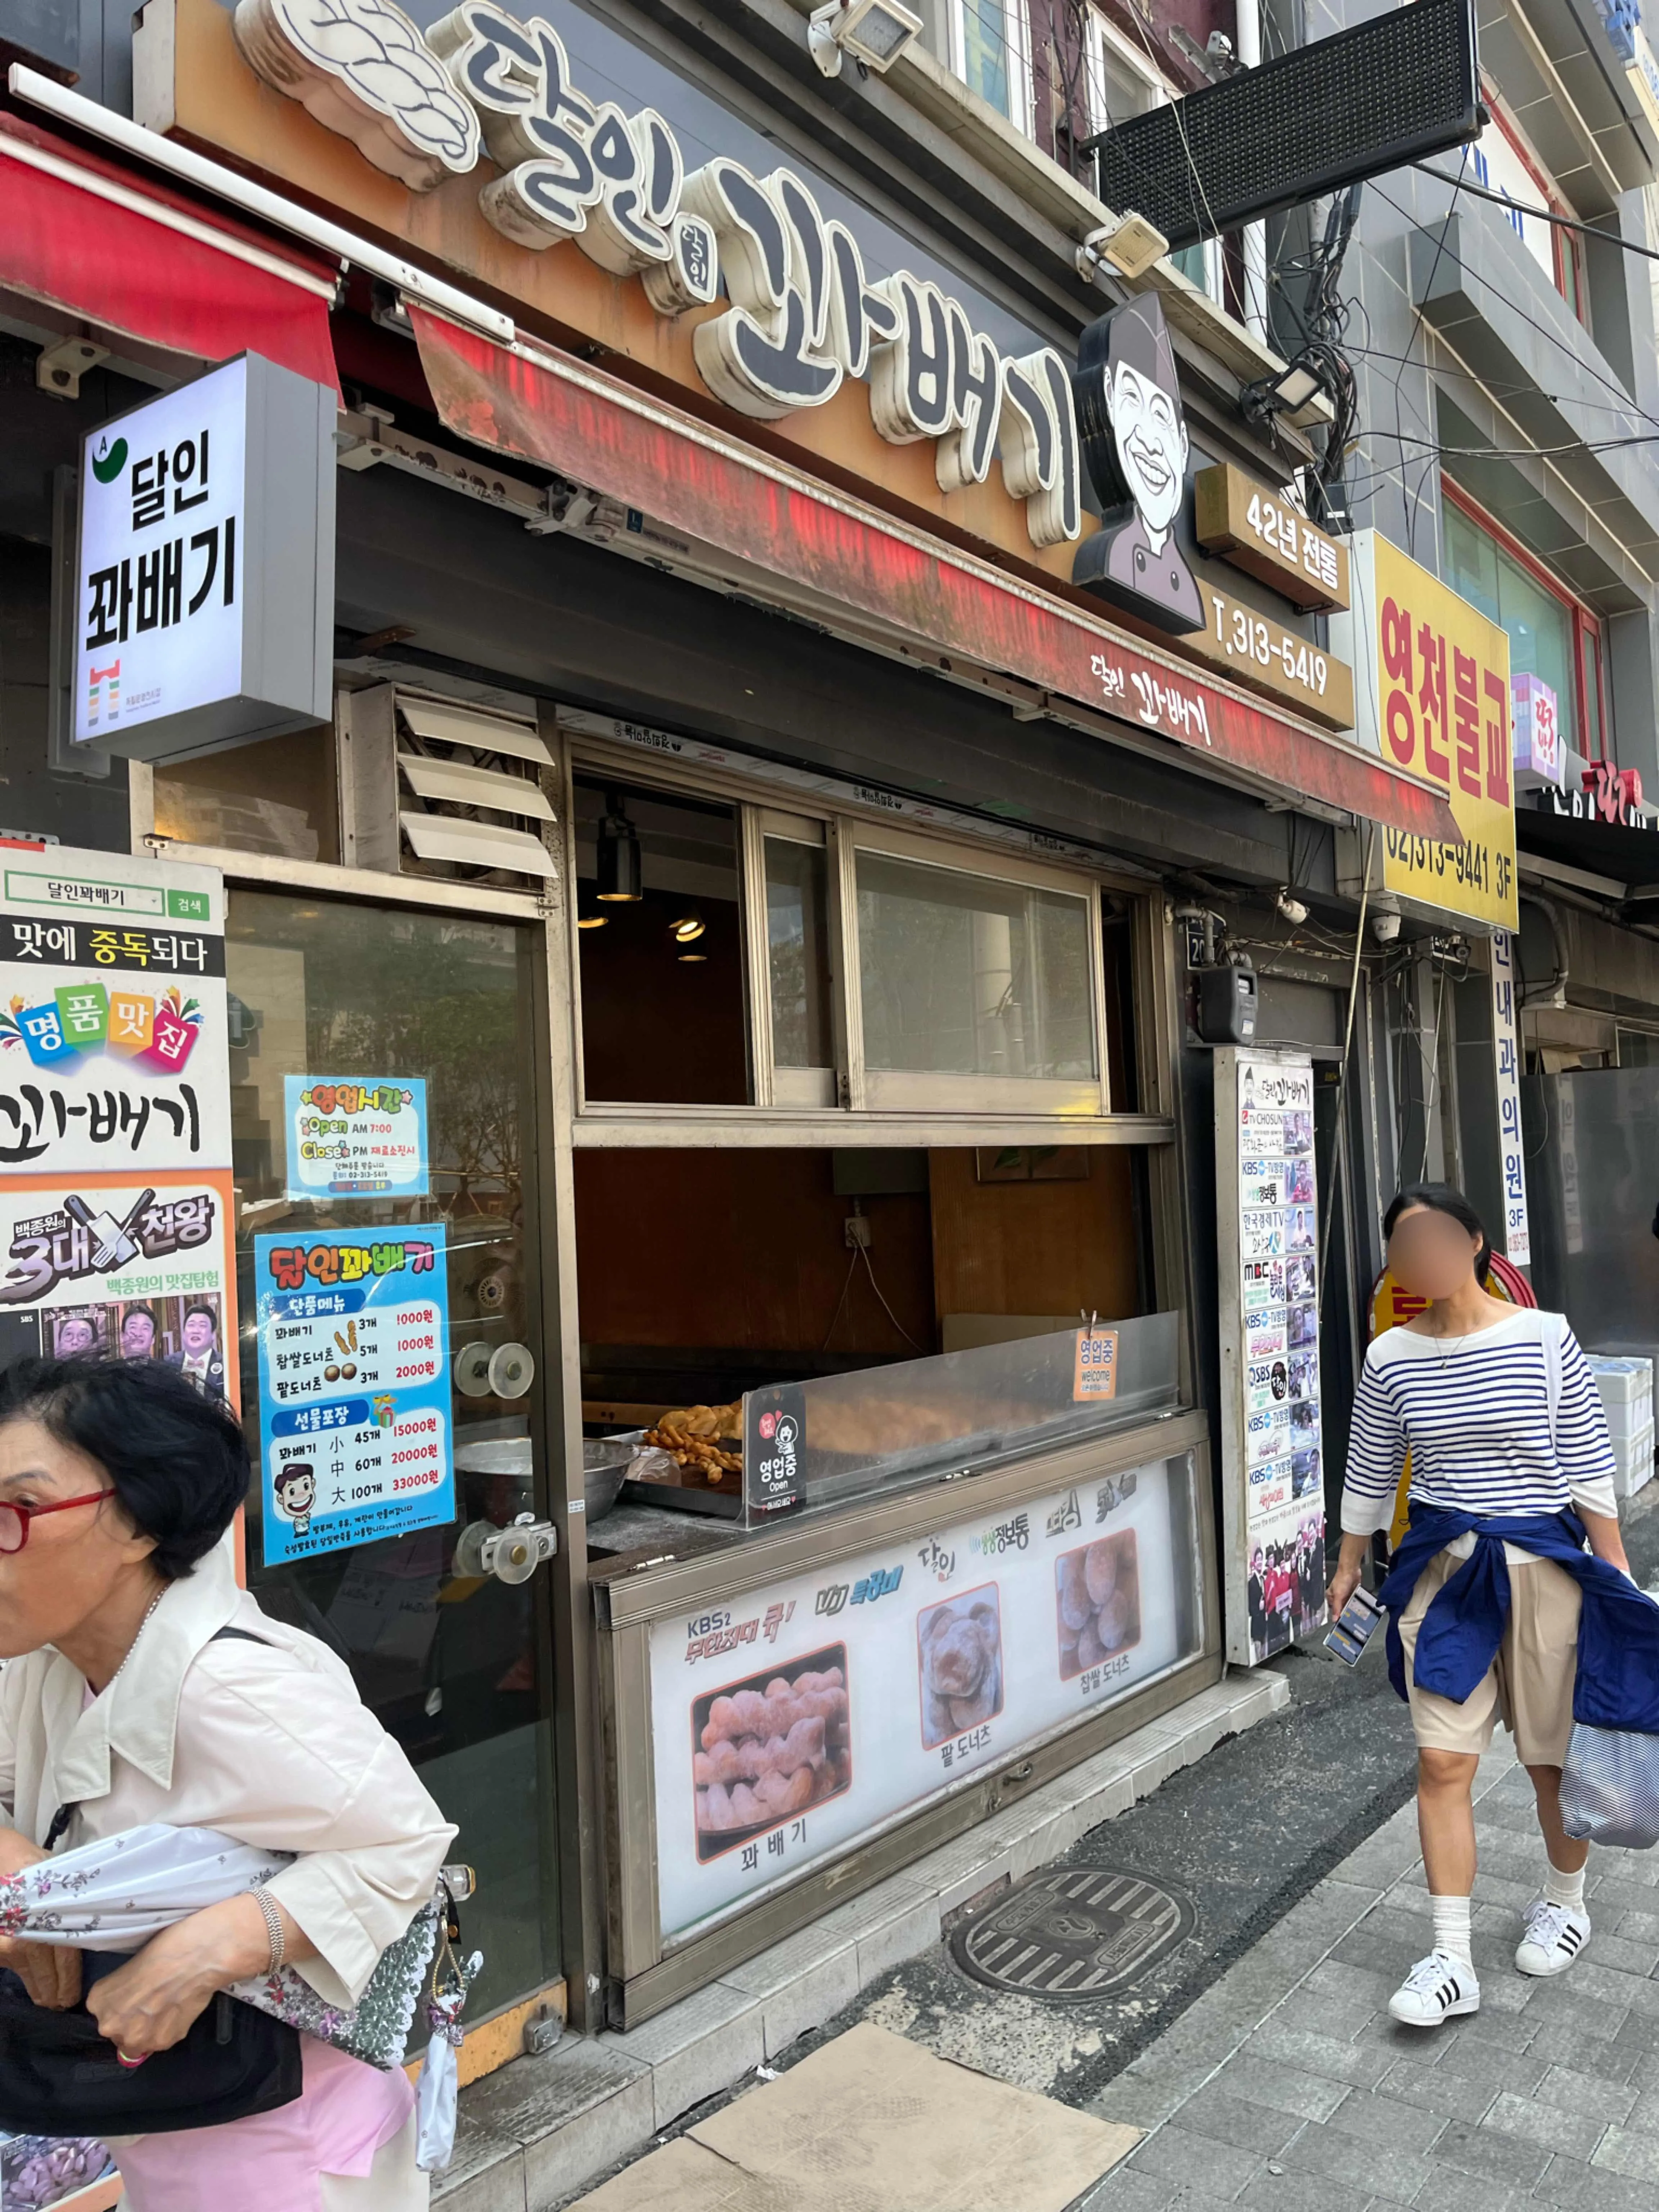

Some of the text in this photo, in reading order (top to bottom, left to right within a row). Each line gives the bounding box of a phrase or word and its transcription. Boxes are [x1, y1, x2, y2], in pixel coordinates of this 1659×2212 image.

[464, 7, 679, 254] 달인
[715, 160, 1079, 538] 꽈배기
[131, 429, 209, 532] 달인
[1247, 494, 1338, 590] 42년 전통
[86, 516, 236, 651] 꽈배기
[1130, 671, 1211, 747] 꽈배기
[1381, 596, 1510, 809] 영천불교
[1496, 852, 1511, 899] 3F
[48, 882, 124, 906] 달인꽈배기
[177, 898, 201, 913] 검색
[13, 923, 208, 972] 맛에 중독되다
[312, 1084, 402, 1114] 영업시간
[309, 1117, 392, 1137] Open AM 7:00
[1257, 1113, 1283, 1125] CHOSUN
[301, 1142, 415, 1159] Close PM 재료소진시
[1243, 1162, 1258, 1175] KBS
[15, 1213, 67, 1239] 백종원의
[141, 1196, 211, 1252] 천왕
[1509, 1208, 1524, 1227] 3F
[107, 1271, 219, 1295] 백종원의 맛집탐험
[270, 1241, 434, 1290] 달인꽈배기
[289, 1295, 345, 1316] 단품메뉴
[1245, 1314, 1260, 1329] KBS
[275, 1309, 433, 1340] 꽈배기 3개 1000원
[276, 1335, 434, 1370] 찹쌀도너츠 5개 1000원
[276, 1361, 435, 1399] 팥도너츠 3개 2000원
[1256, 1365, 1270, 1383] SBS
[295, 1406, 349, 1431] 선물포장
[1248, 1415, 1263, 1433] KBS
[278, 1417, 437, 1460] 꽈배기 小 45개 15000원
[331, 1443, 438, 1478] 中 60개 20000원
[760, 1453, 797, 1483] 영업중
[1250, 1467, 1265, 1485] KBS
[331, 1469, 439, 1505] 大 100개 33000원
[769, 1480, 788, 1492] Open
[981, 1512, 1030, 1556] 생생정보통
[849, 1564, 905, 1605] 특공대
[685, 1618, 760, 1664] 무한지대
[1080, 1655, 1130, 1695] 찹쌀 도너츠
[940, 1725, 992, 1768] 팥 도너츠
